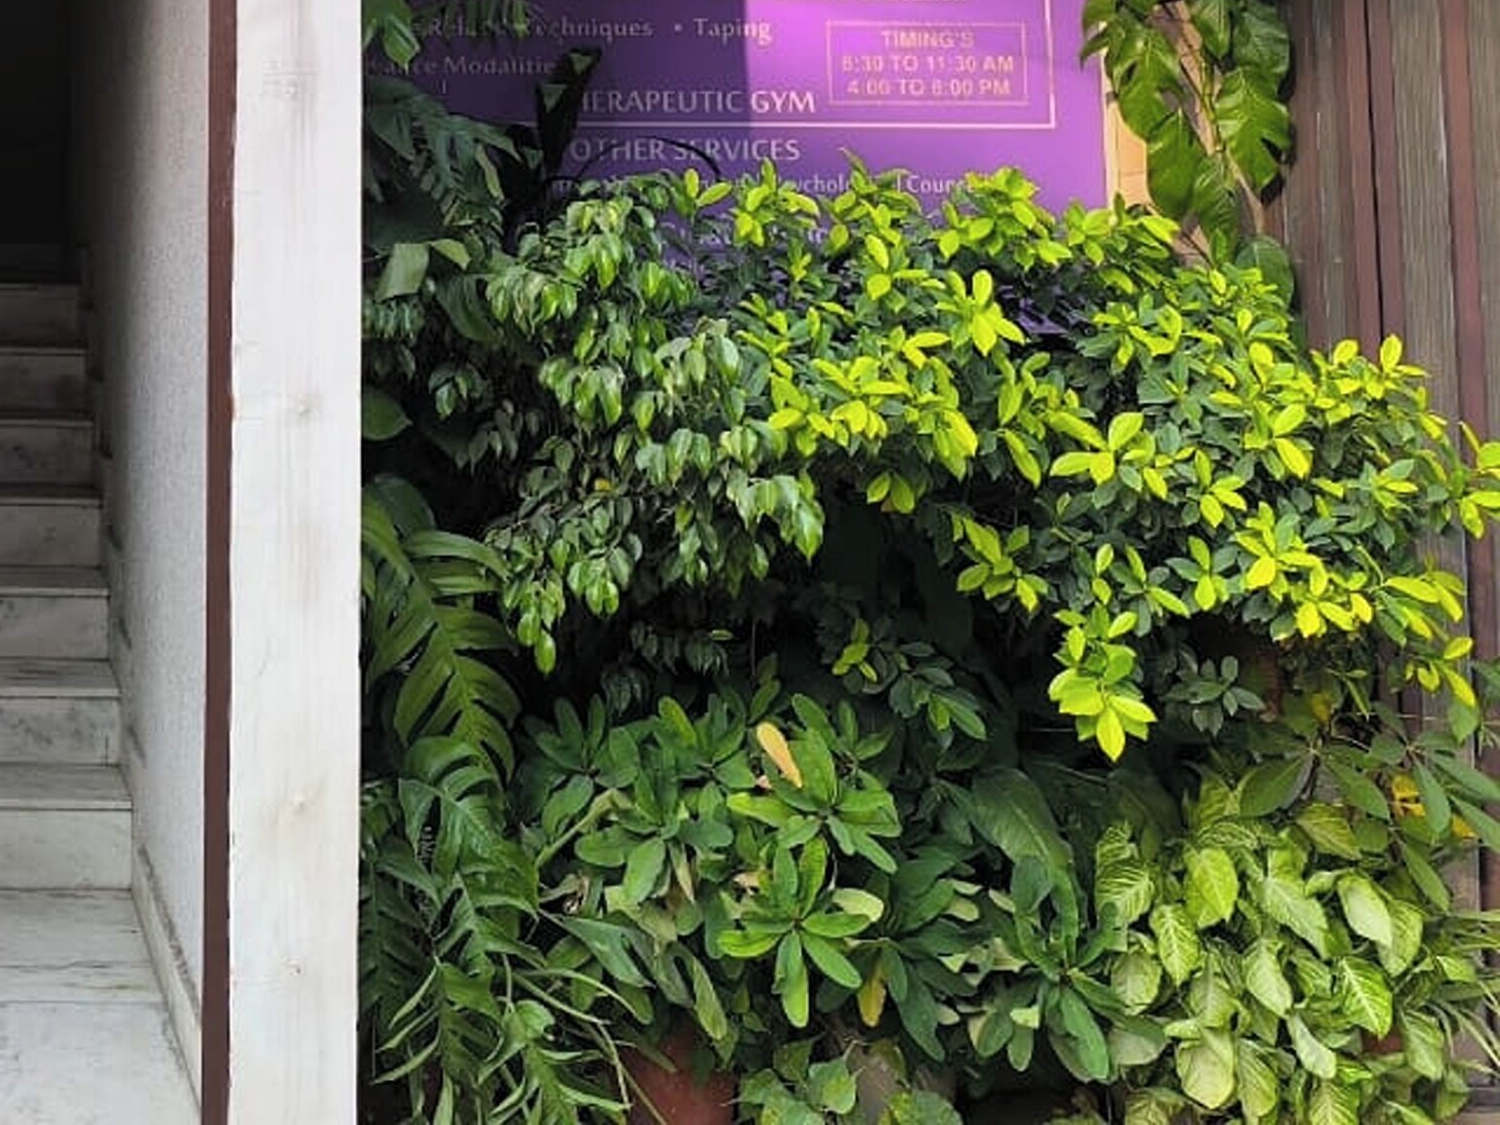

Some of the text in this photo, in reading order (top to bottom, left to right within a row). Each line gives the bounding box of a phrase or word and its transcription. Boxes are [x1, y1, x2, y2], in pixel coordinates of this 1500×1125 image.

[530, 17, 653, 43] echniques
[693, 18, 773, 46] Taping
[881, 30, 975, 49] TIMING'S
[443, 55, 558, 75] Modalitie
[891, 55, 918, 73] TO
[982, 56, 1015, 74] AM
[898, 79, 925, 97] TO
[979, 79, 1011, 97] PM
[749, 90, 817, 114] GYM
[570, 138, 800, 162] OTHER SERVICES
